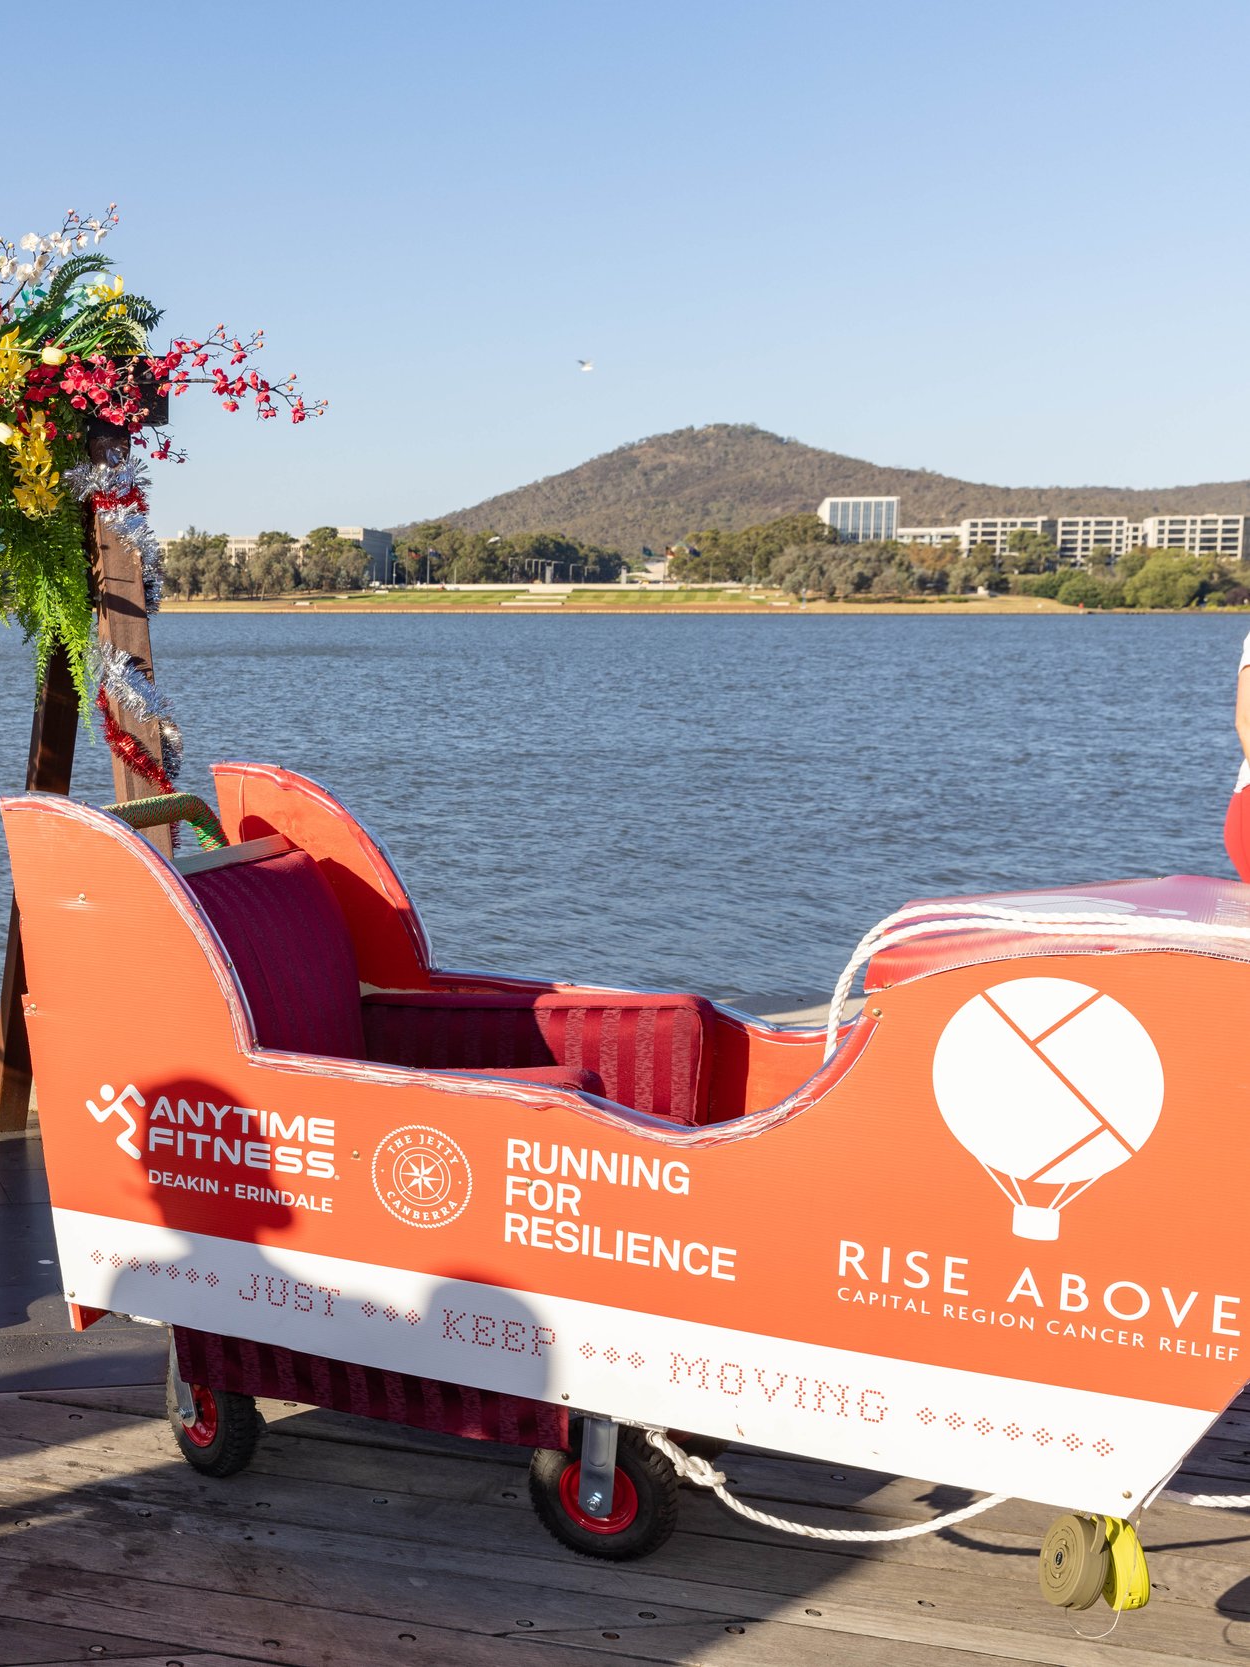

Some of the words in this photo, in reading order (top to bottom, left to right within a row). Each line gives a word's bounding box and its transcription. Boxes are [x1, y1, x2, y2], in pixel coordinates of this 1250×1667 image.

[150, 1095, 335, 1146] ANYTIME
[148, 1127, 335, 1180] FITNESS
[387, 1135, 412, 1154] THE
[419, 1134, 459, 1164] JETTY
[506, 1138, 690, 1196] RUNNING
[148, 1169, 219, 1195] DEAKIN
[234, 1184, 333, 1214] ERINDALE
[387, 1191, 458, 1221] CANBERRA
[505, 1175, 582, 1217] FOR
[504, 1212, 737, 1282] RESILIENCE
[837, 1240, 969, 1296] RISE
[1006, 1267, 1241, 1336] ABOVE
[238, 1273, 341, 1317] JUST
[442, 1308, 556, 1356] KEEP
[669, 1352, 889, 1423] MOVING
[837, 1287, 931, 1316] CAPITAL
[943, 1304, 1035, 1332] REGION
[1046, 1319, 1145, 1348] CANCER
[1159, 1336, 1240, 1362] RELIEF
